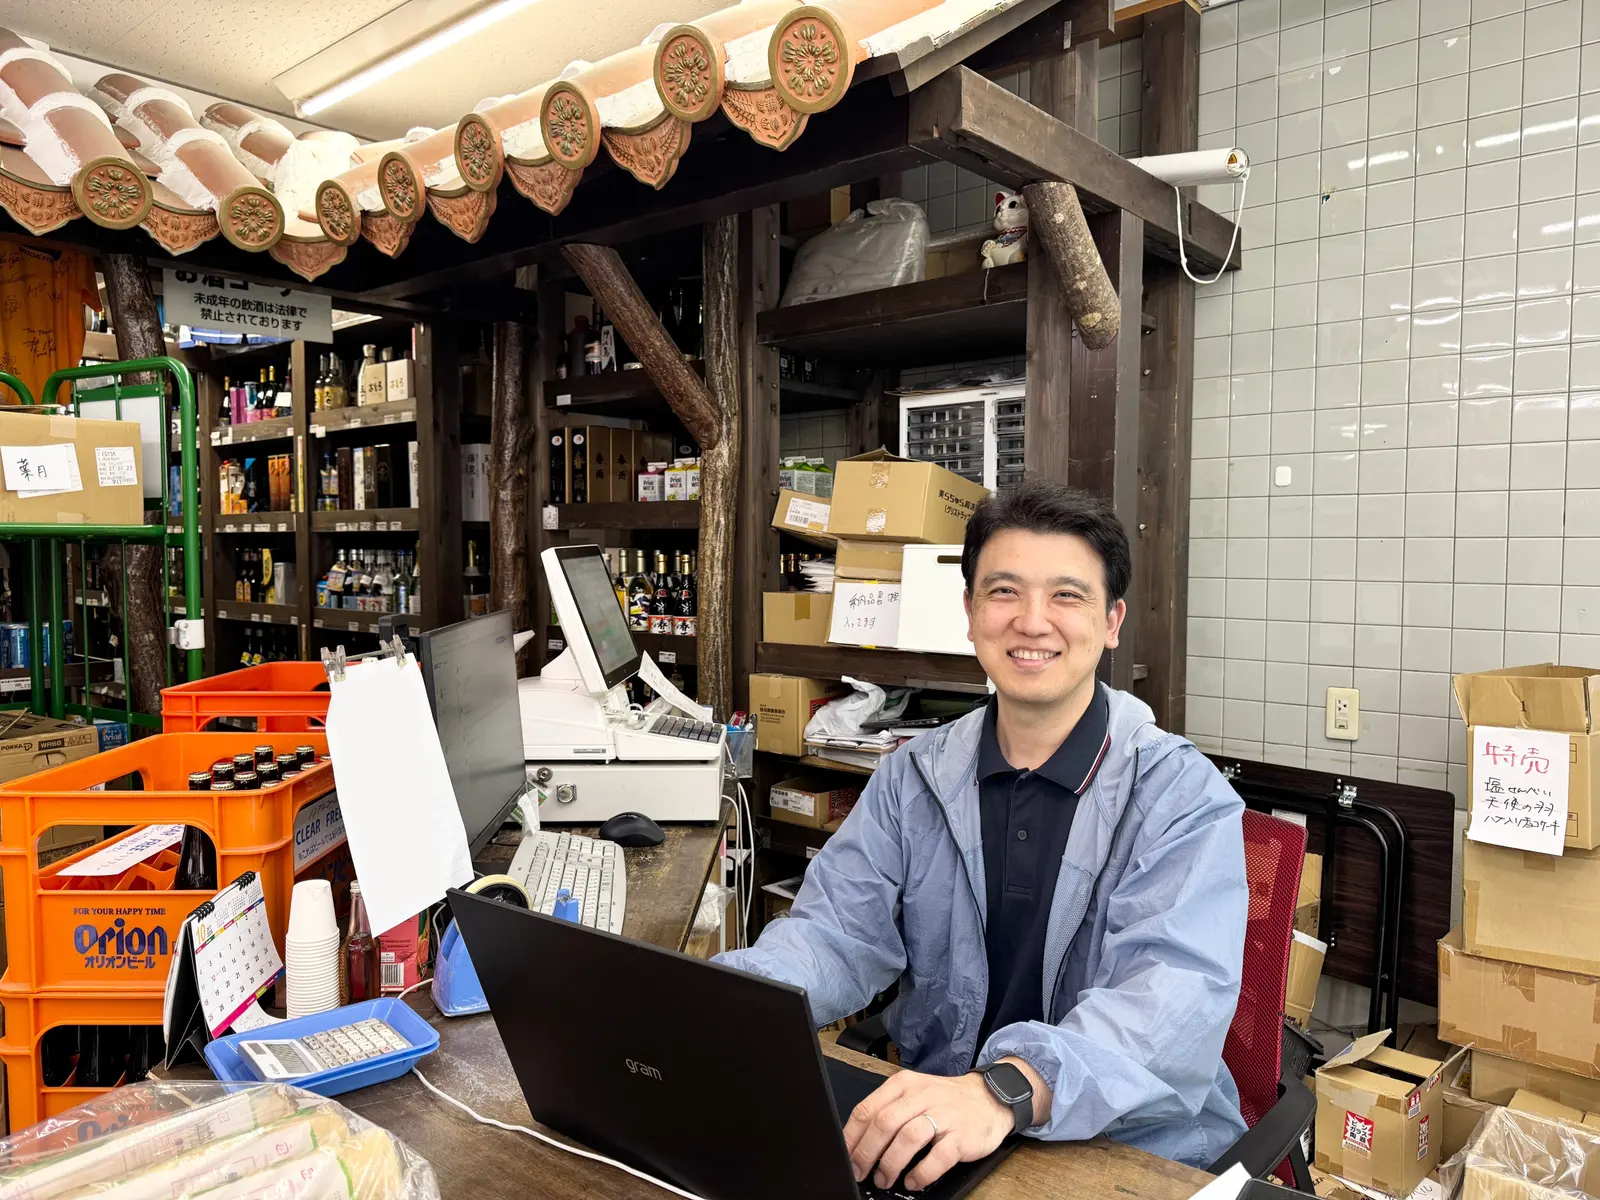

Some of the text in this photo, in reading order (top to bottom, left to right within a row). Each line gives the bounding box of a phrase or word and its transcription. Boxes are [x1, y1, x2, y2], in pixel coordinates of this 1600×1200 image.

[193, 292, 308, 318] 未成年の飲酒は法律で
[200, 308, 303, 331] 禁止されております
[17, 458, 48, 481] 葉月
[0, 743, 23, 751] POKKA
[1481, 742, 1550, 775] 特売
[295, 818, 321, 846] CLEAR
[73, 907, 166, 916] FOR YOUR HAPPY TIME
[74, 918, 168, 955] Orion
[195, 923, 206, 945] 10
[84, 955, 156, 969] オリオンビール
[625, 1058, 663, 1081] gram
